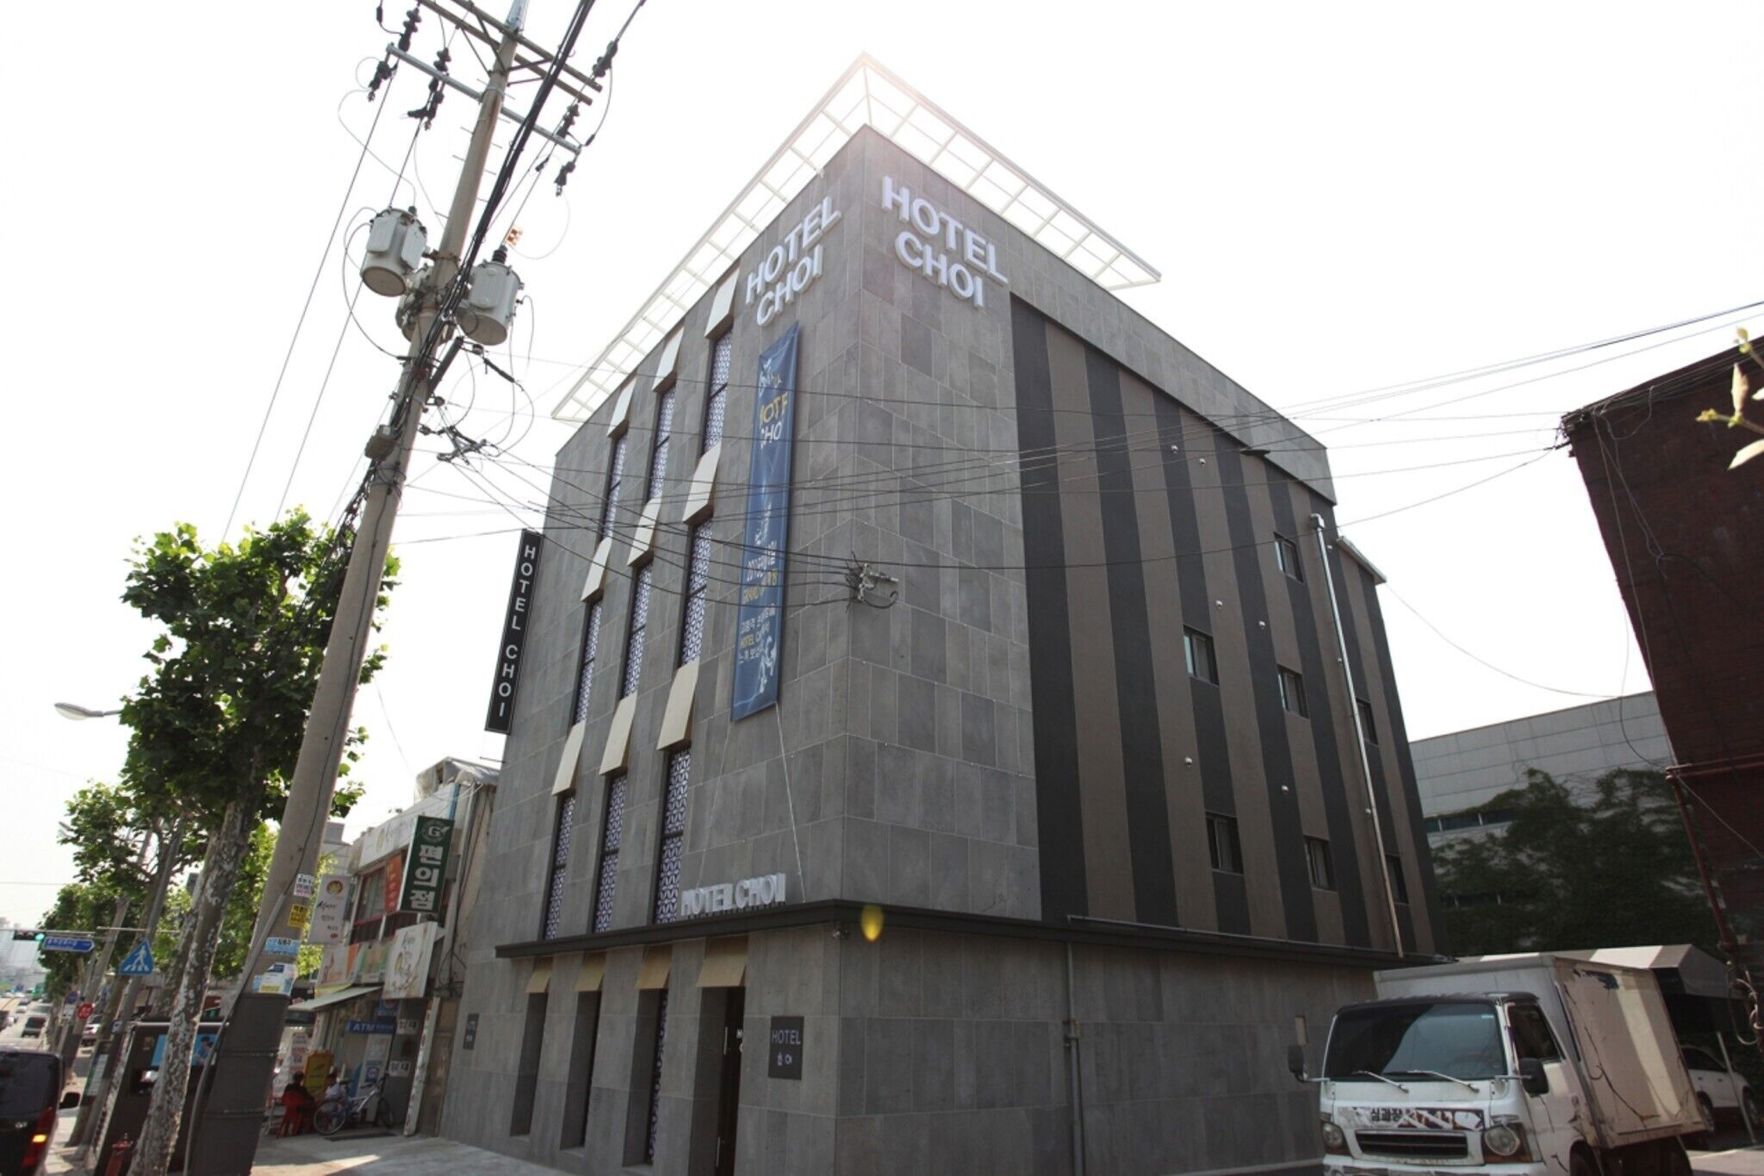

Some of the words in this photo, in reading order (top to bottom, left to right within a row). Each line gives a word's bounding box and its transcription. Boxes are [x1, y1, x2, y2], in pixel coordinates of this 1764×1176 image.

[745, 196, 842, 304] HOTEL
[882, 175, 1008, 284] HOTEL
[757, 244, 823, 326] CHOI
[895, 231, 984, 308] CHOI
[511, 545, 536, 630] HOTEL
[498, 644, 518, 717] CHOI
[410, 844, 443, 910] 편의점
[680, 883, 734, 917] HOTEL
[735, 872, 786, 909] CHOI
[353, 1023, 375, 1031] ATM
[772, 1030, 801, 1044] HOTEL
